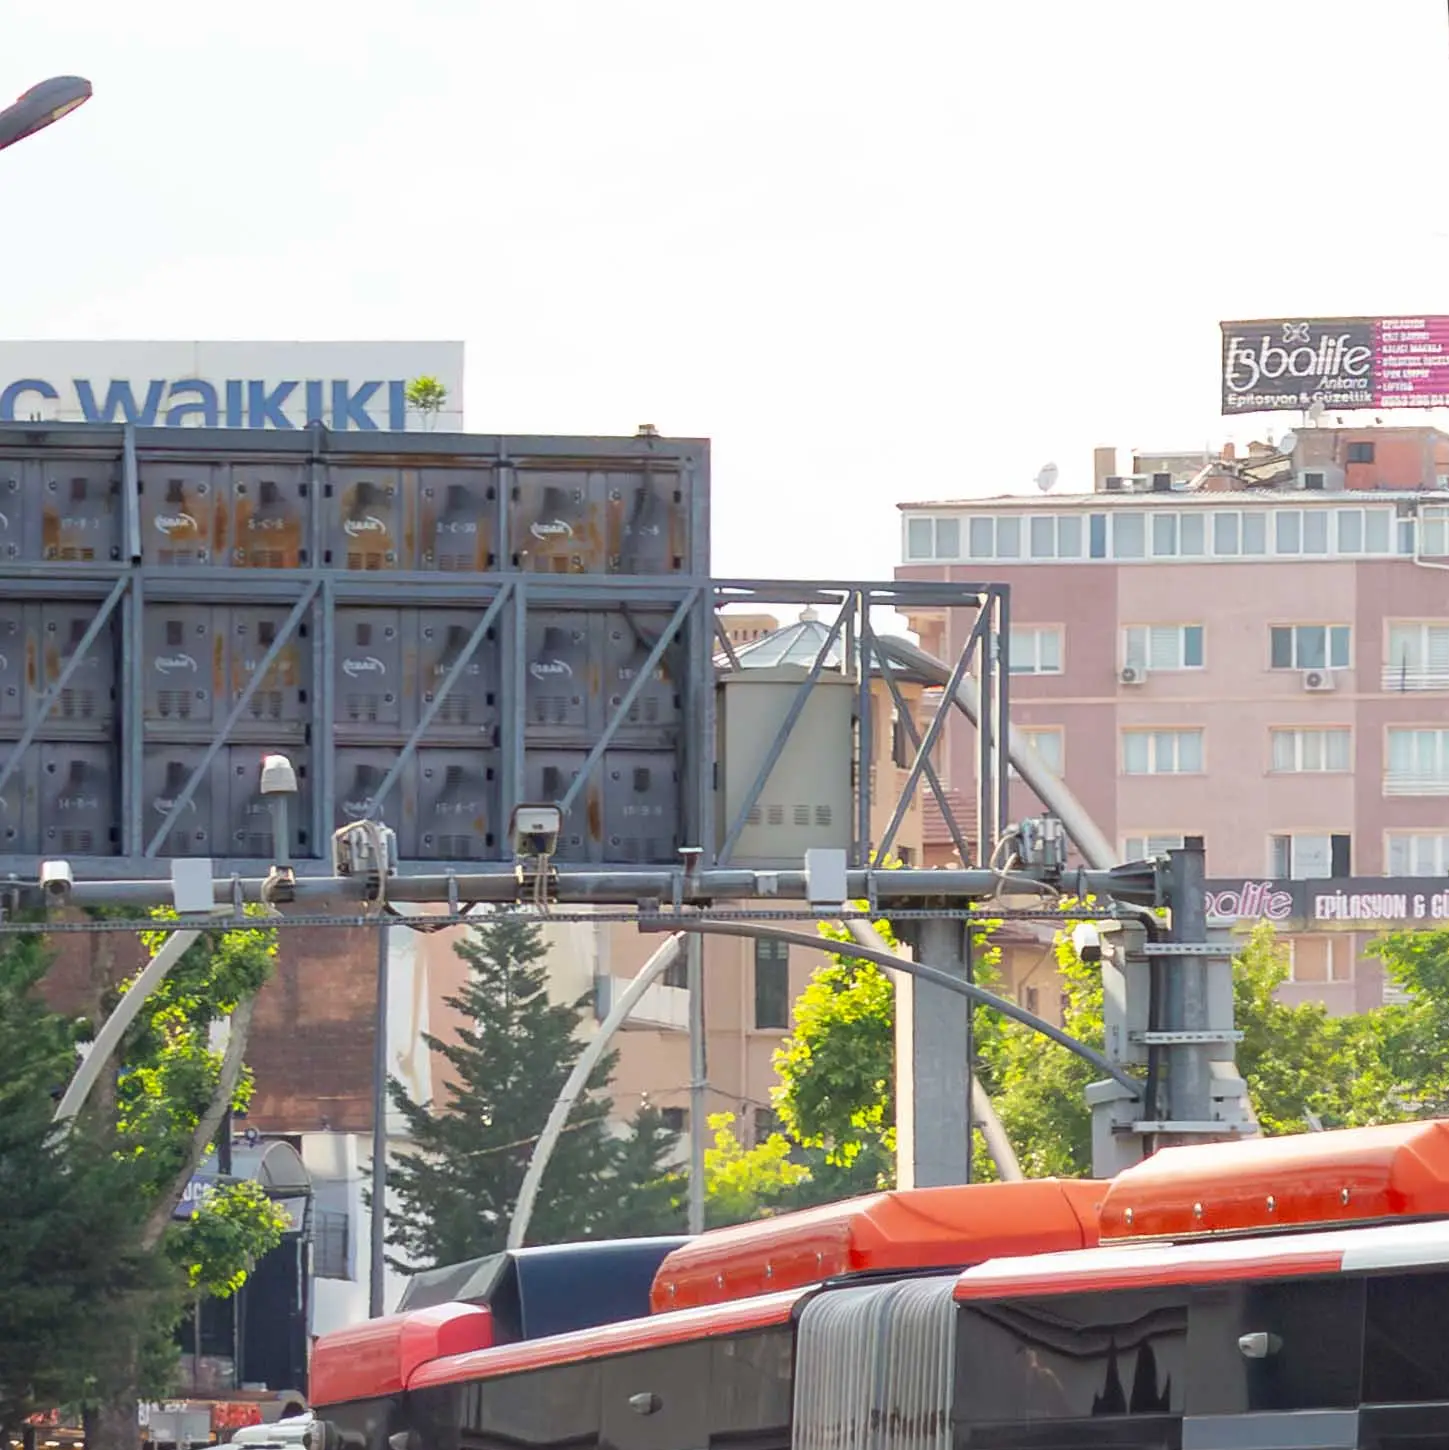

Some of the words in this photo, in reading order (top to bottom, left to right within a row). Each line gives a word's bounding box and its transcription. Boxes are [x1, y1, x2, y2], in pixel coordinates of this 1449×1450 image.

[1225, 334, 1372, 392] Esbalife
[1316, 377, 1368, 390] Ankara
[1227, 393, 1298, 405] Epilasyon
[1300, 392, 1310, 402] &
[1312, 390, 1373, 403] Güzellik
